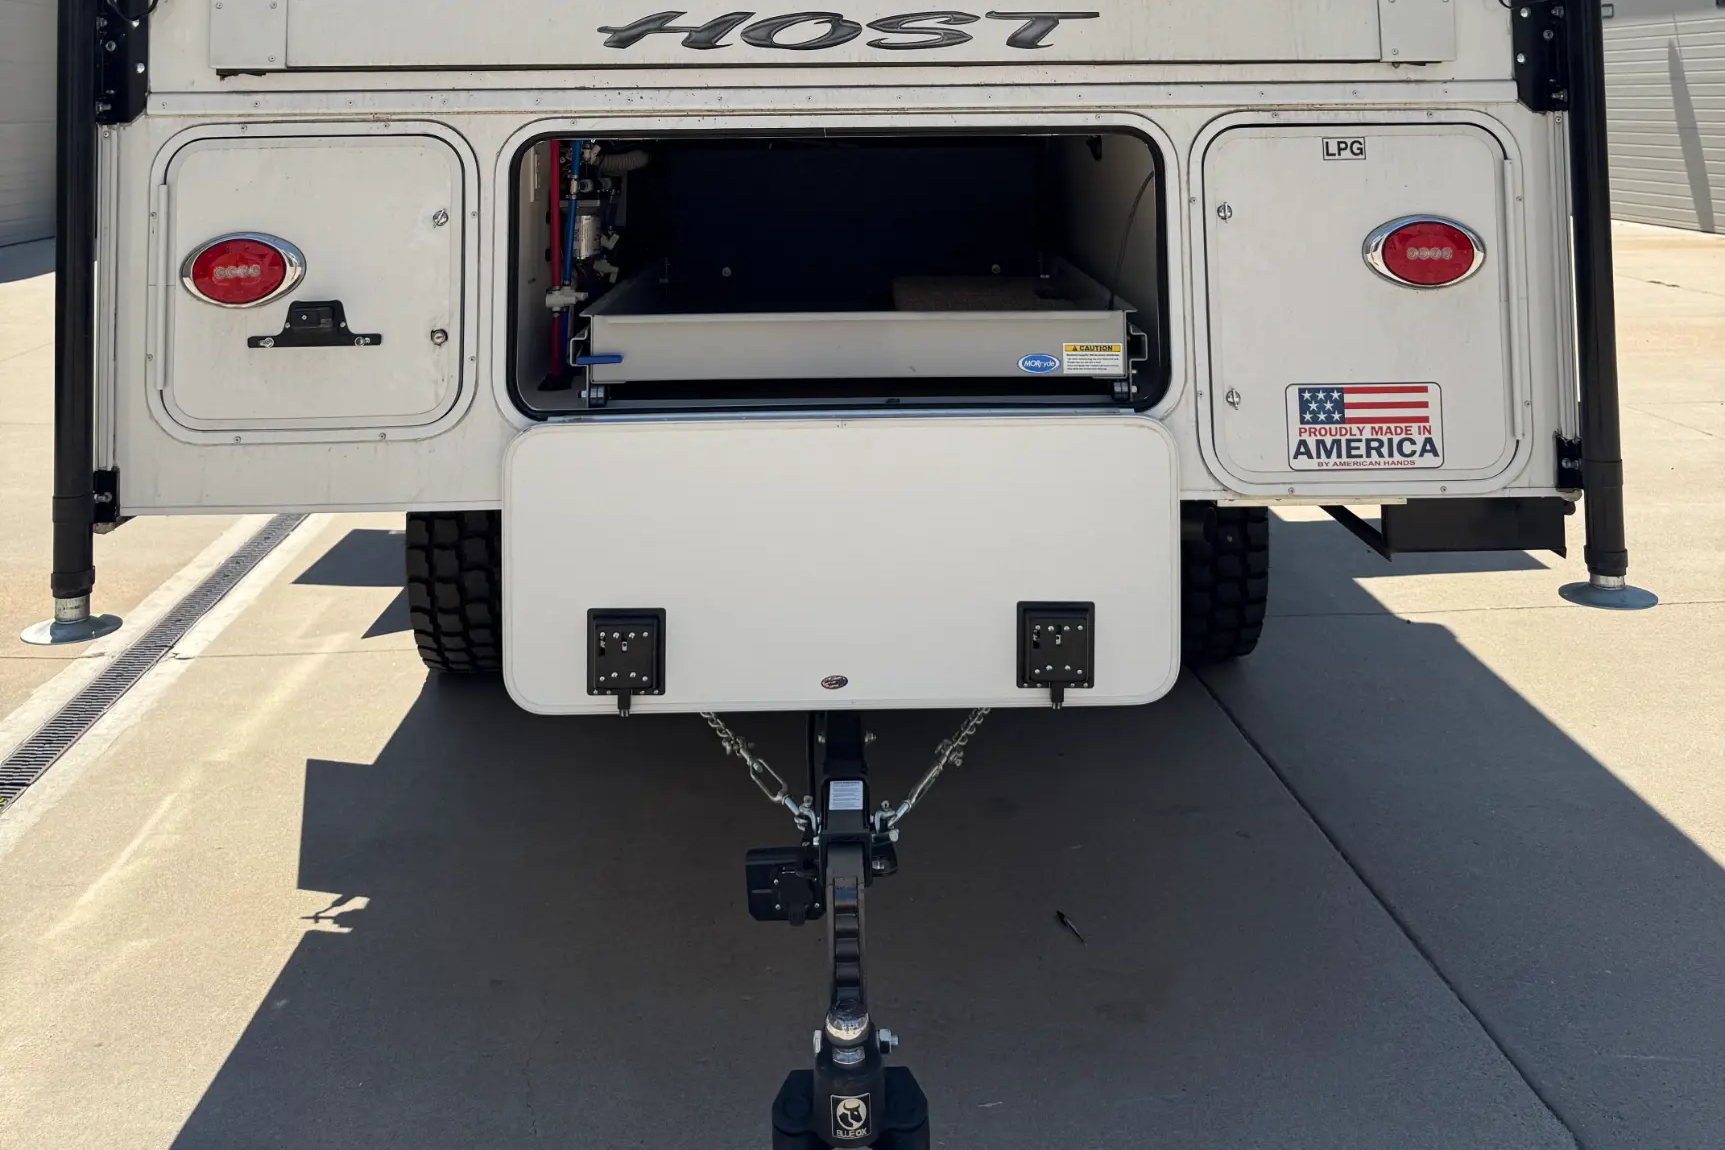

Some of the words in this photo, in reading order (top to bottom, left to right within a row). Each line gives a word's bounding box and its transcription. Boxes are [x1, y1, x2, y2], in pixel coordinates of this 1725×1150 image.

[597, 10, 1100, 50] HOST
[1325, 140, 1364, 157] LPG
[1299, 426, 1365, 437] PROUDLY
[1371, 425, 1413, 436] MADE
[1418, 425, 1432, 435] IN
[1293, 437, 1440, 459] AMERICA
[855, 1128, 867, 1136] OX
